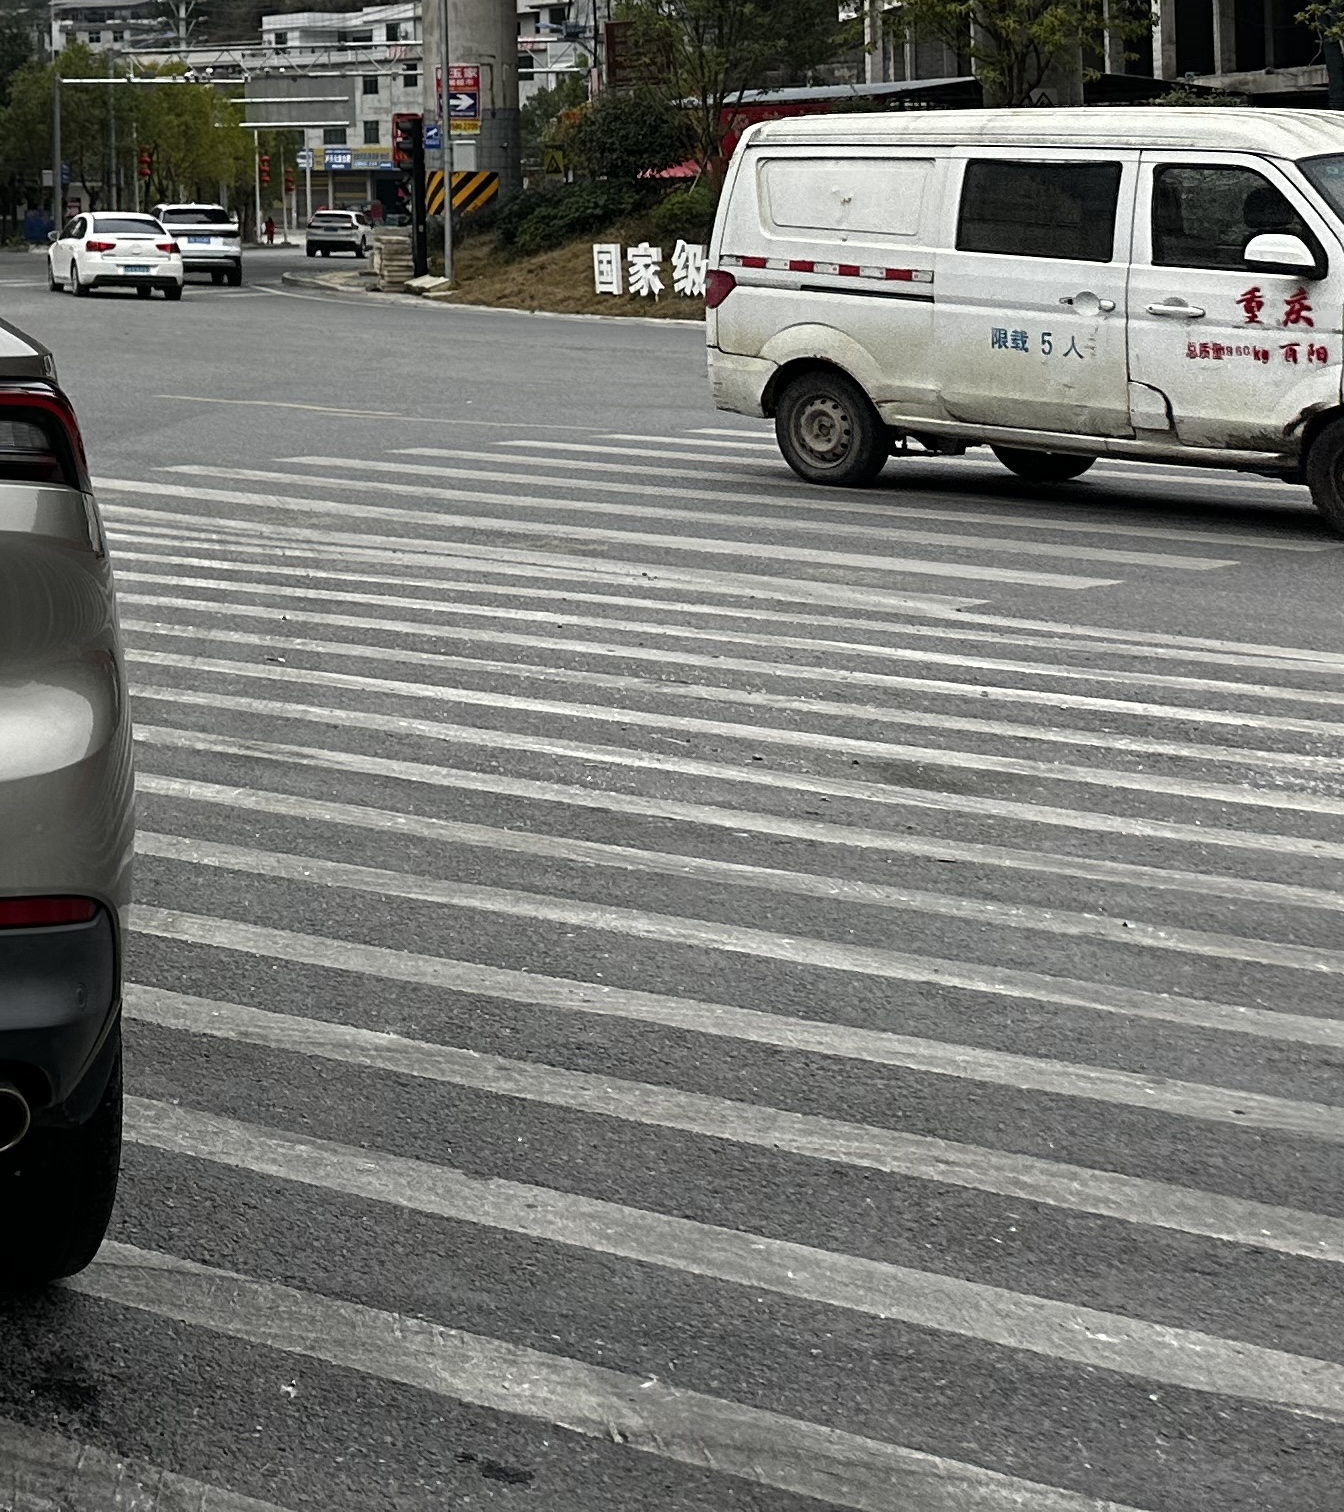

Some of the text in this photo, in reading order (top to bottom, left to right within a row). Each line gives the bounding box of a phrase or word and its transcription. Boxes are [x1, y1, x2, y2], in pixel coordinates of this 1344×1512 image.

[1235, 286, 1315, 328] 重庆
[991, 326, 1029, 354] 限载
[1040, 331, 1053, 356] 5
